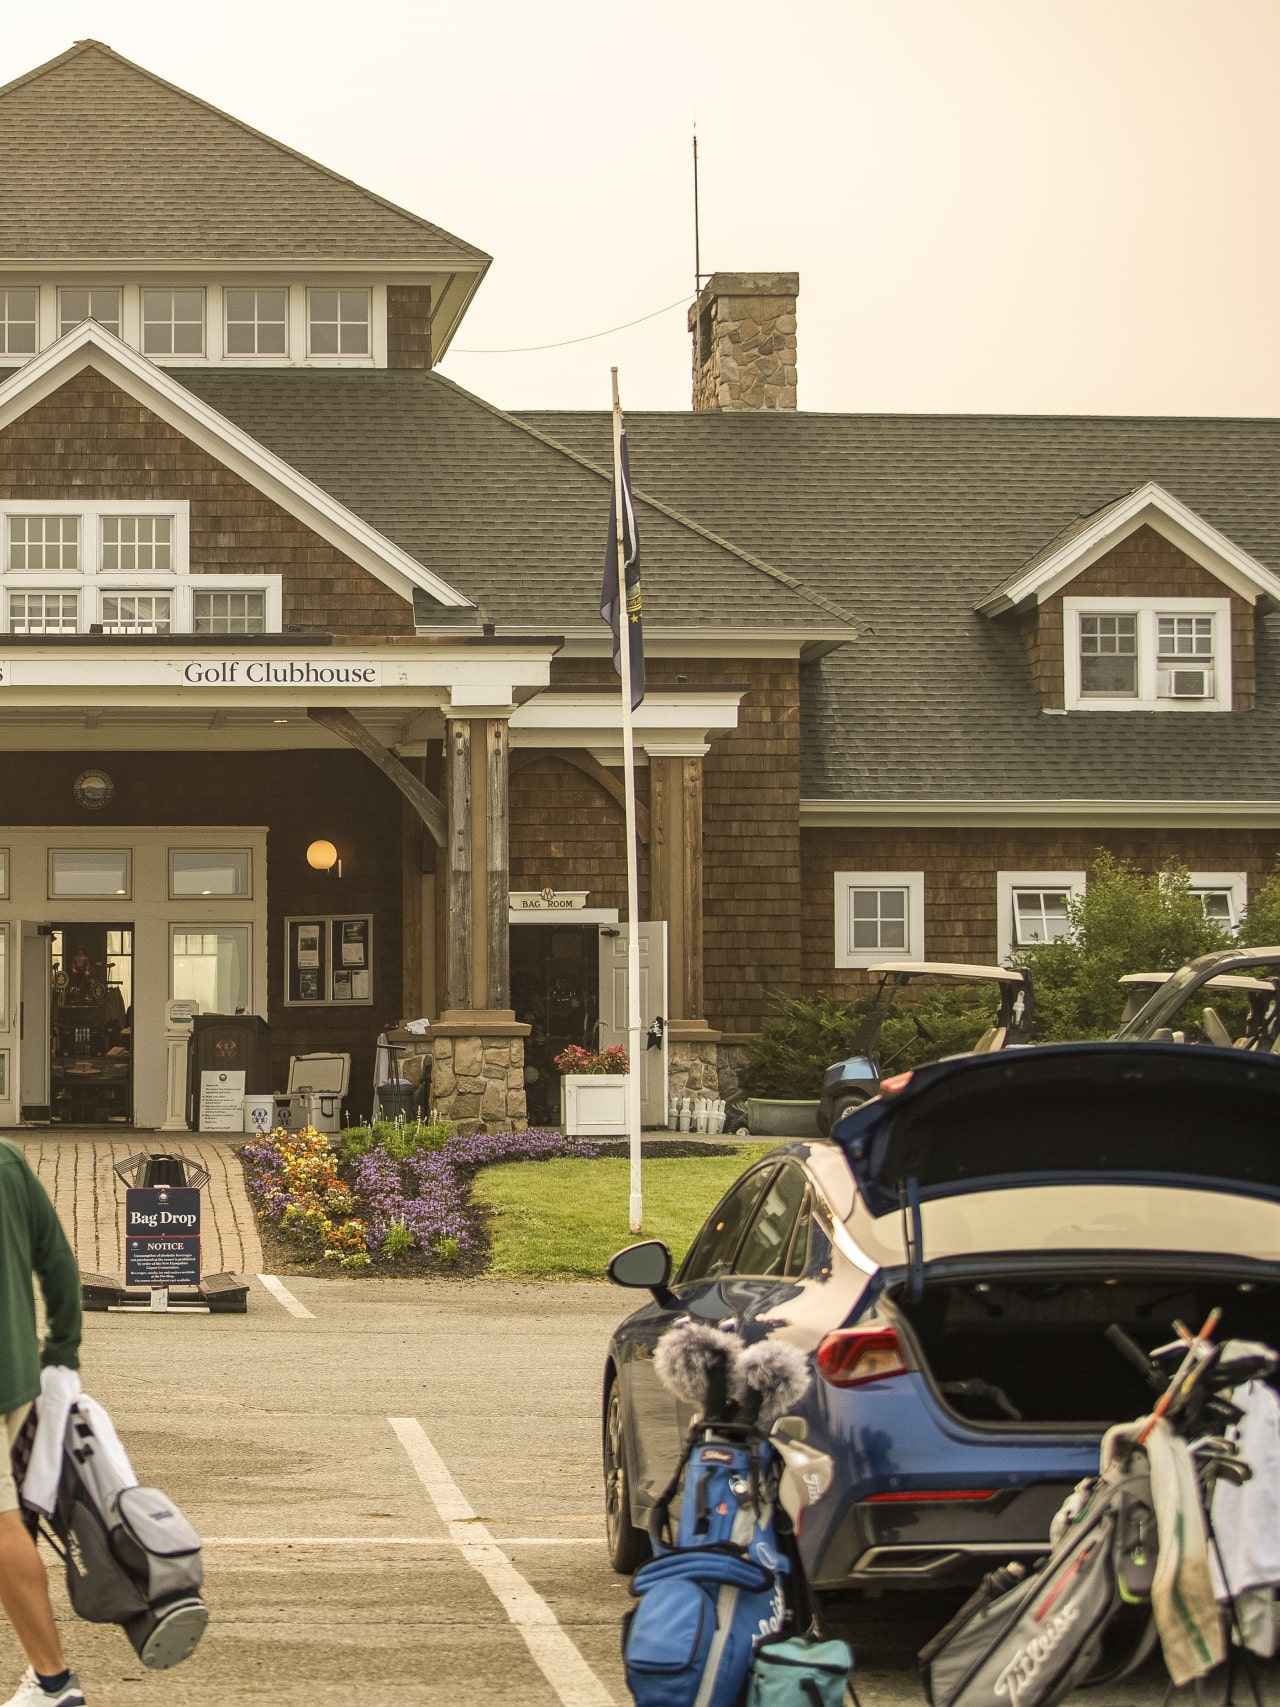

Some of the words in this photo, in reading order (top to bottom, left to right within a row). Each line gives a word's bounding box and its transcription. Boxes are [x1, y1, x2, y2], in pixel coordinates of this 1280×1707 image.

[184, 661, 239, 683] Golf
[246, 661, 376, 683] Clubhouse
[522, 900, 541, 908] BAG
[547, 900, 573, 908] ROOM
[130, 1211, 158, 1227] Bag
[160, 1211, 197, 1227] Drop
[147, 1242, 184, 1250] NOTICE
